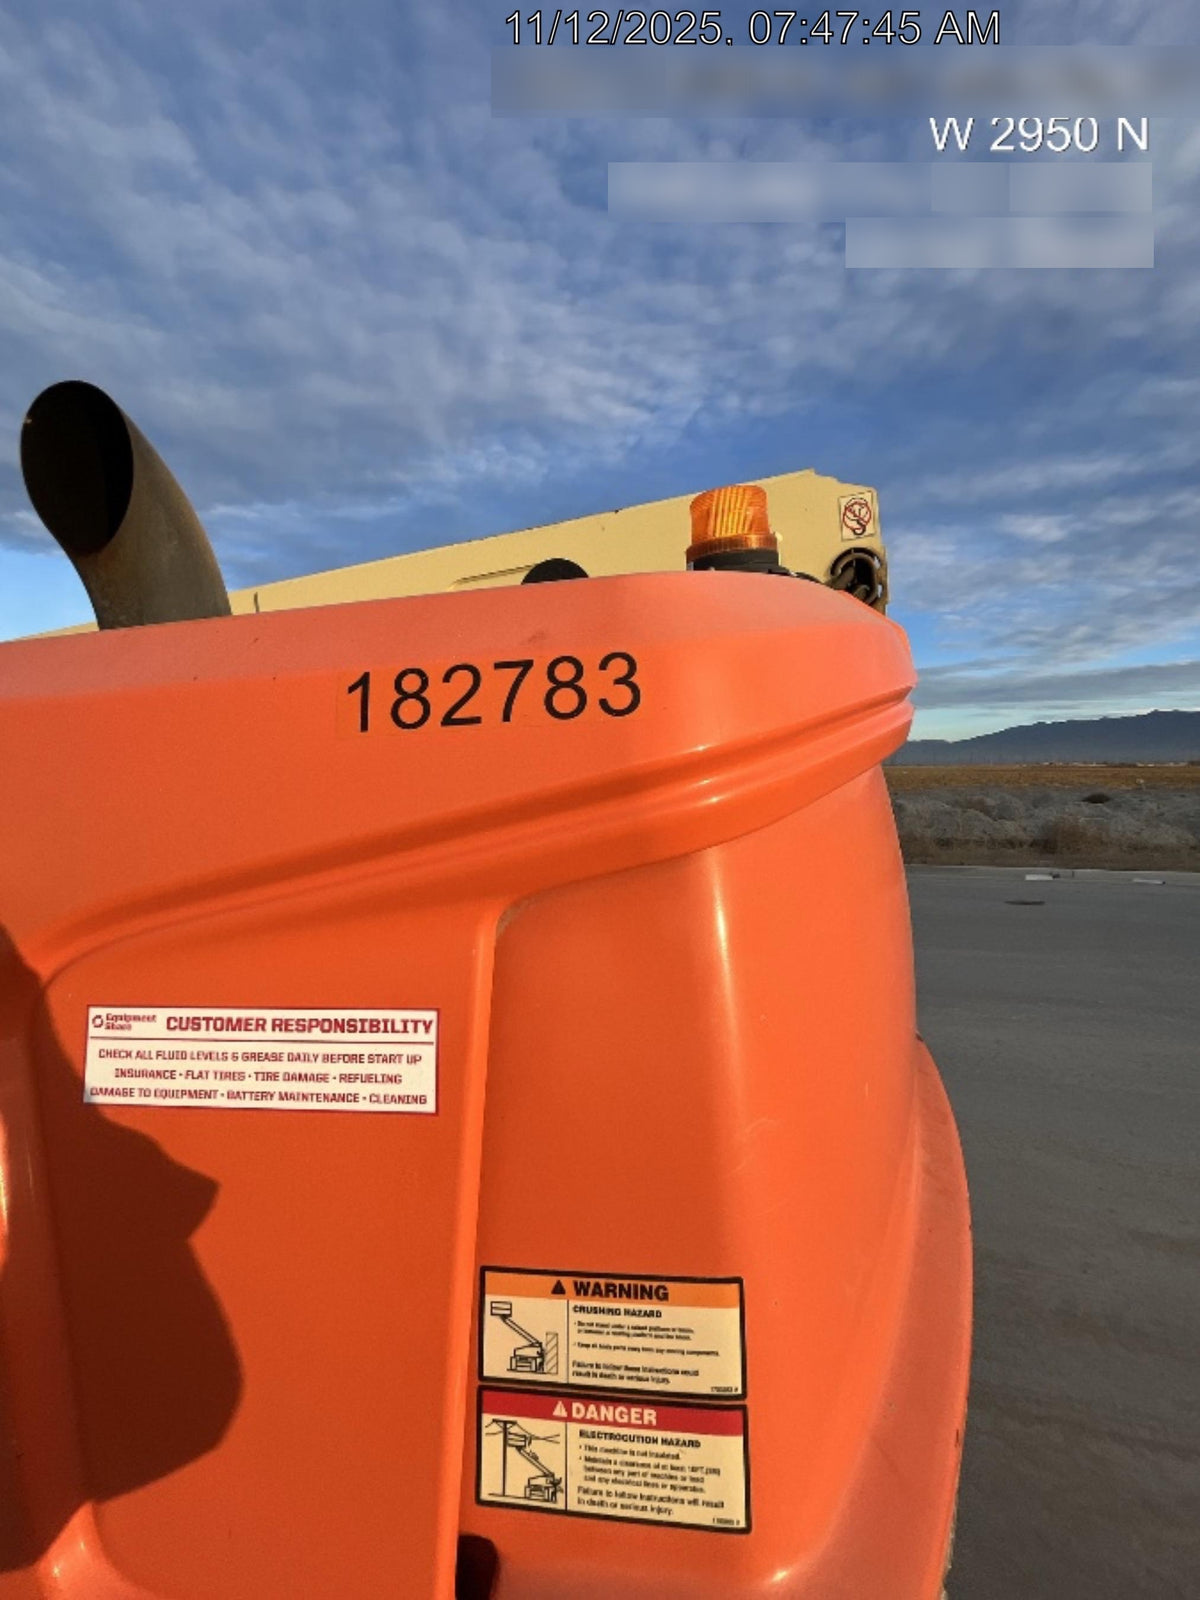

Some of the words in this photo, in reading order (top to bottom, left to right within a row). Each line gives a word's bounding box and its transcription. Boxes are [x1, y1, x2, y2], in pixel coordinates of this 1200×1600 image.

[347, 652, 641, 733] 182783
[166, 1016, 266, 1032] CUSTOMER
[271, 1018, 433, 1034] RESPONSIBILITY
[98, 1049, 132, 1059] CHECK
[134, 1050, 153, 1060] ALL
[156, 1050, 187, 1061] FLUID
[190, 1051, 228, 1062] LEVELS
[241, 1051, 284, 1063] GREASE
[287, 1052, 319, 1063] DAILY
[322, 1053, 364, 1064] BEFORE
[368, 1053, 403, 1064] START
[406, 1054, 422, 1065] UP
[115, 1069, 176, 1080] INSURANCE
[185, 1069, 210, 1081] FLAT
[213, 1070, 246, 1081] TIRES
[254, 1071, 280, 1082] TIRE
[283, 1072, 330, 1083] DAMAGE
[339, 1073, 402, 1084] REFUELING
[90, 1087, 135, 1097] DAMAGE
[137, 1088, 151, 1098] TO
[154, 1089, 218, 1100] EQUIPMENT
[226, 1090, 275, 1101] BATTERY
[278, 1091, 359, 1102] MAINTENANCE
[369, 1093, 427, 1105] CLEANING
[573, 1280, 669, 1301] WARNING
[573, 1305, 621, 1316] CRUSHING
[624, 1308, 662, 1318] HAZARD
[572, 1402, 657, 1426] DANGER
[579, 1429, 658, 1445] ELECTROCUTION
[661, 1437, 701, 1448] HAZARD
